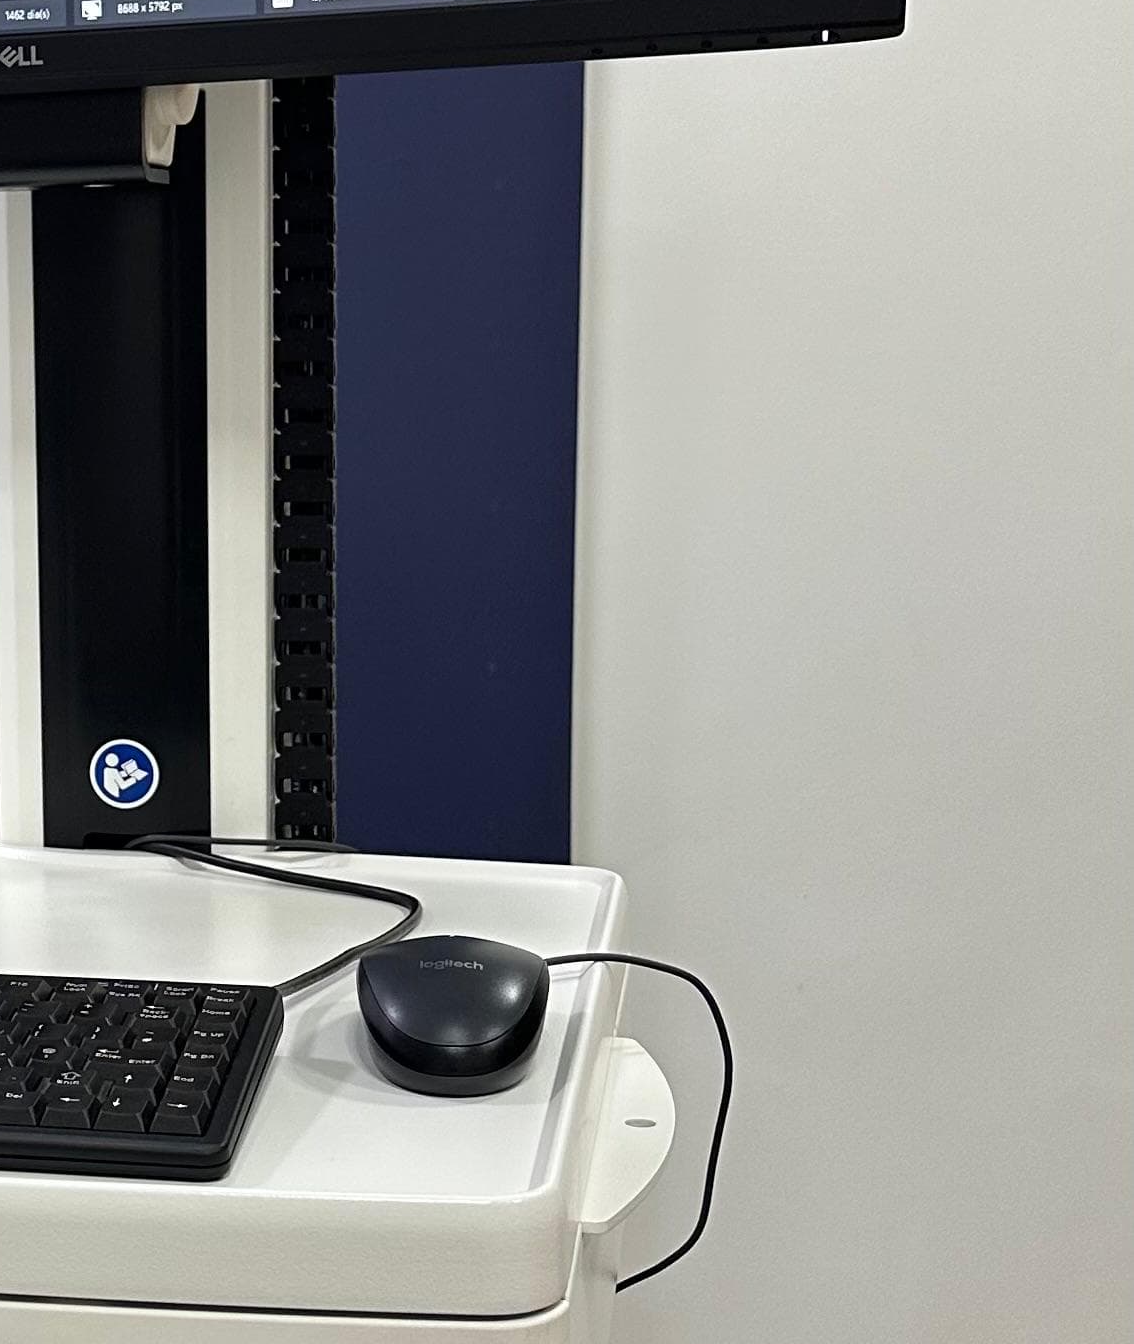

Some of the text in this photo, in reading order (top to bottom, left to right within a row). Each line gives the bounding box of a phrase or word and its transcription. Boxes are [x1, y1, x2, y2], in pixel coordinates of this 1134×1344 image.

[148, 1, 170, 13] 5792
[171, 2, 183, 13] px
[4, 8, 51, 21] 1462 dia(s)
[419, 958, 484, 971] logitech
